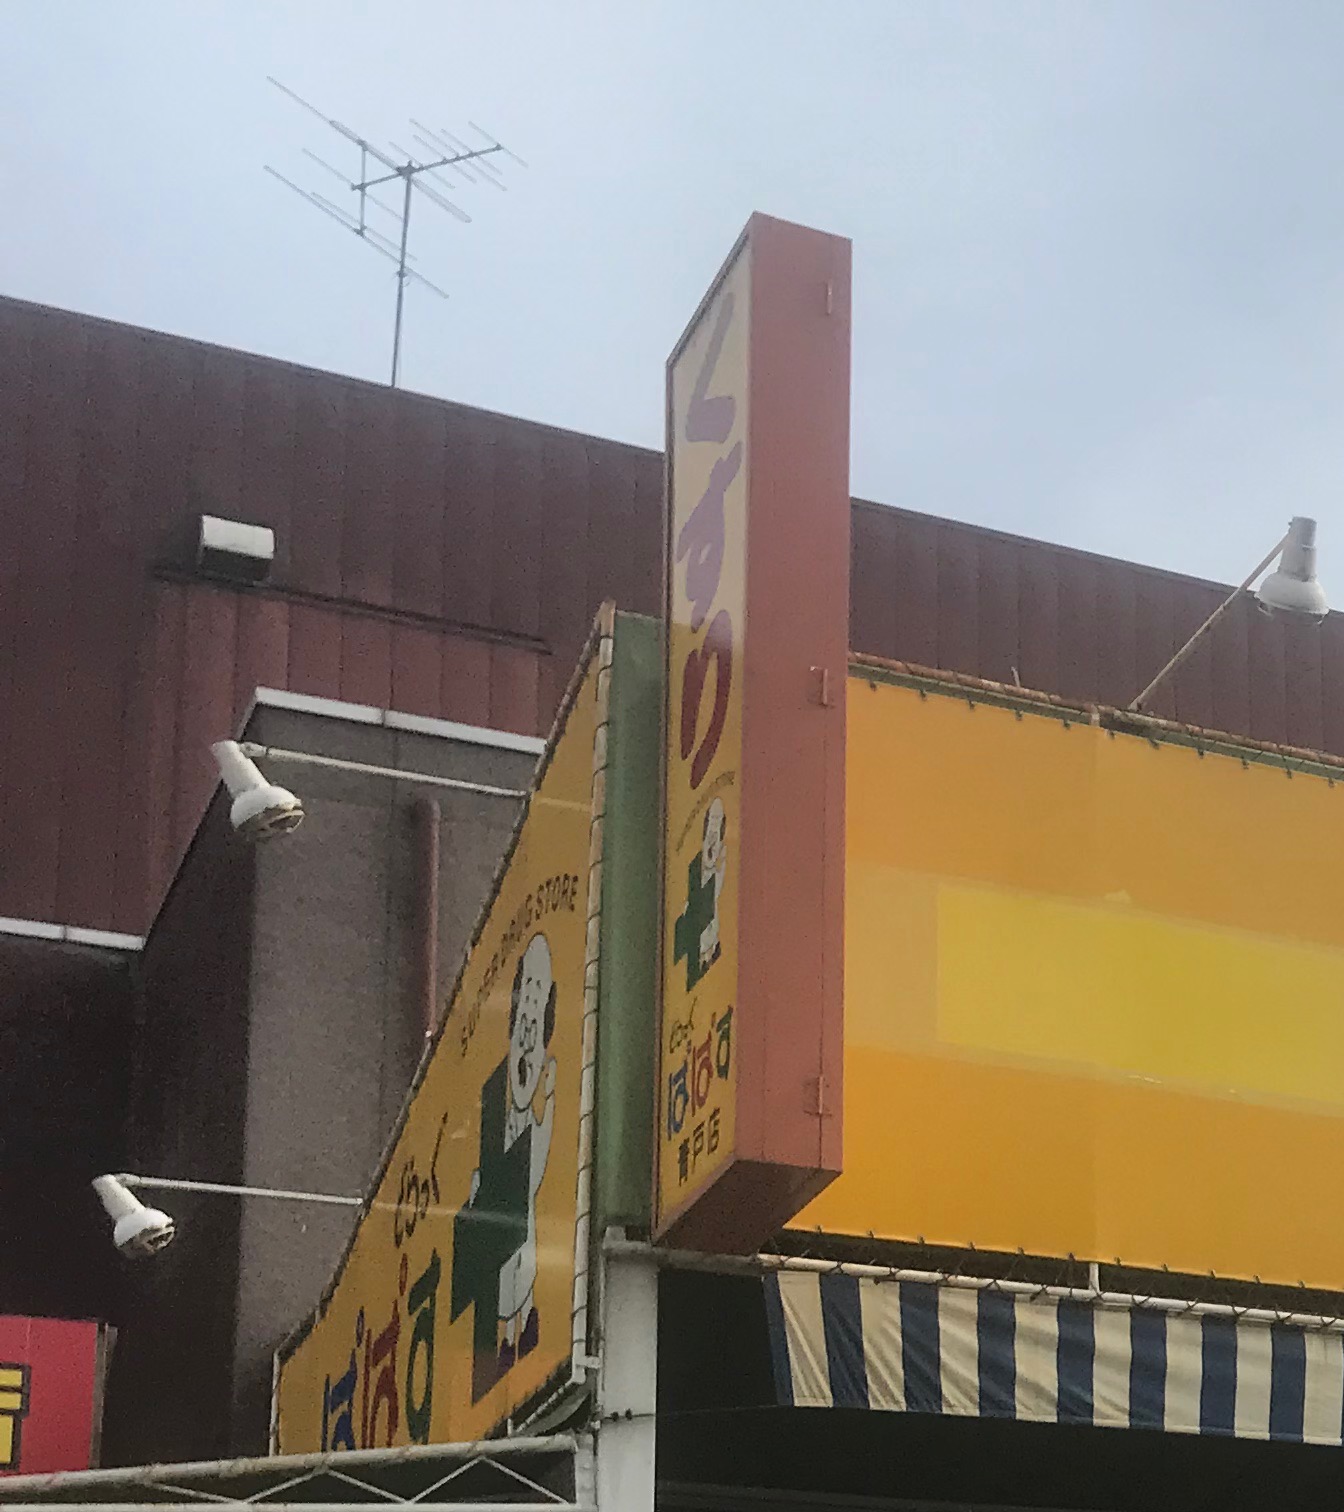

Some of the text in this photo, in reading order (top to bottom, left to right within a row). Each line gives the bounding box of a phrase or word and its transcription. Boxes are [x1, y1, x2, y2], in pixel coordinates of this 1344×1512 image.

[677, 293, 741, 789] くすり
[535, 872, 580, 922] STORE
[668, 1005, 734, 1141] ぱぱす
[678, 1107, 721, 1187] 青戸店
[321, 1248, 442, 1453] ぱぱす
